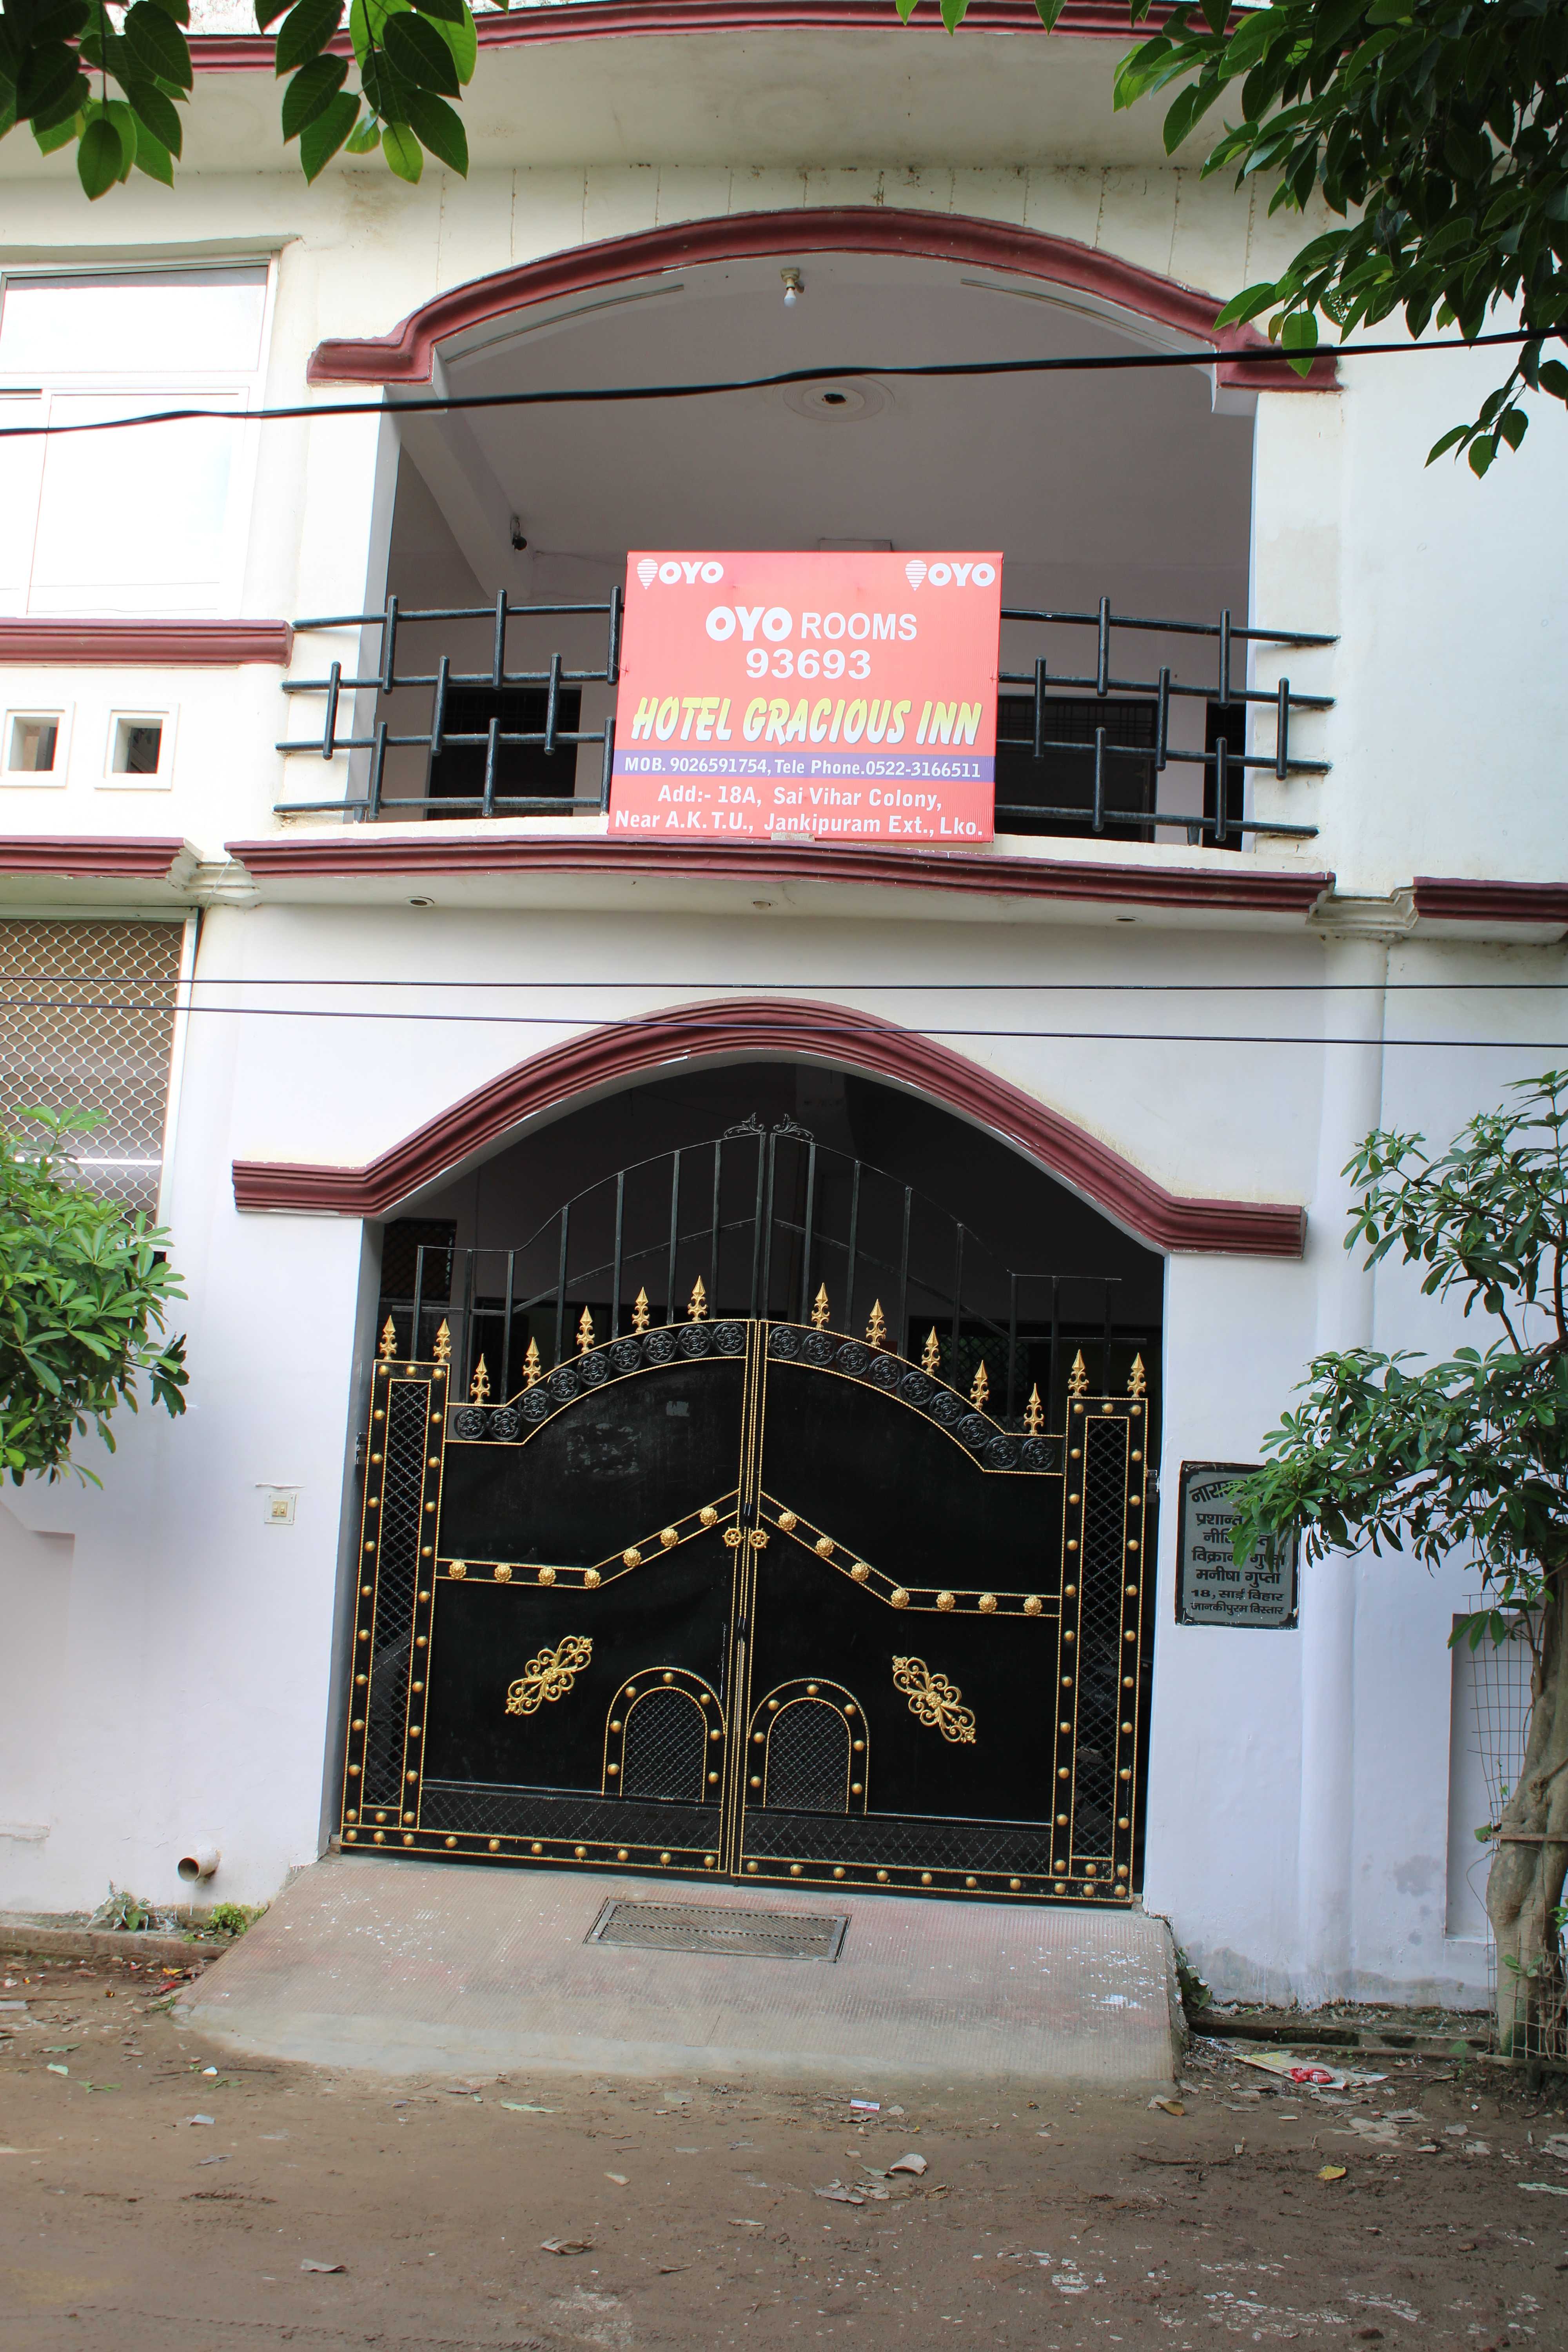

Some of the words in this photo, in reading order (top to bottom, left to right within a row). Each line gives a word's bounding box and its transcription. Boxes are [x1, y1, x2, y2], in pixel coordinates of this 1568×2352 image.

[659, 561, 724, 584] OYO
[928, 563, 995, 587] OYO
[706, 606, 793, 642] OYO
[801, 612, 917, 641] ROOMS
[746, 648, 871, 679] 93693
[630, 696, 732, 741] HOTEL
[742, 697, 911, 745] GRACIOUS
[916, 701, 983, 745] INN
[624, 757, 666, 771] MOB.
[670, 757, 771, 776] 9026591754,
[774, 759, 804, 774] Tele
[658, 785, 711, 802] Add:-
[718, 786, 761, 808] 18A,
[773, 787, 802, 804] Sai
[809, 787, 861, 805] Vihar
[869, 788, 941, 811] Colony,
[615, 810, 660, 828] Near
[764, 813, 880, 835] Jankipuram
[889, 815, 934, 838] Ext.,
[940, 817, 983, 836] Lko.
[1196, 1566, 1240, 1582] मनीषा
[1245, 1572, 1281, 1588] गुप्ता
[1191, 1590, 1215, 1599] 18,
[1247, 1589, 1284, 1601] विहार
[1191, 1601, 1248, 1615] जानकीपुरम
[1250, 1603, 1284, 1614] विस्तार
